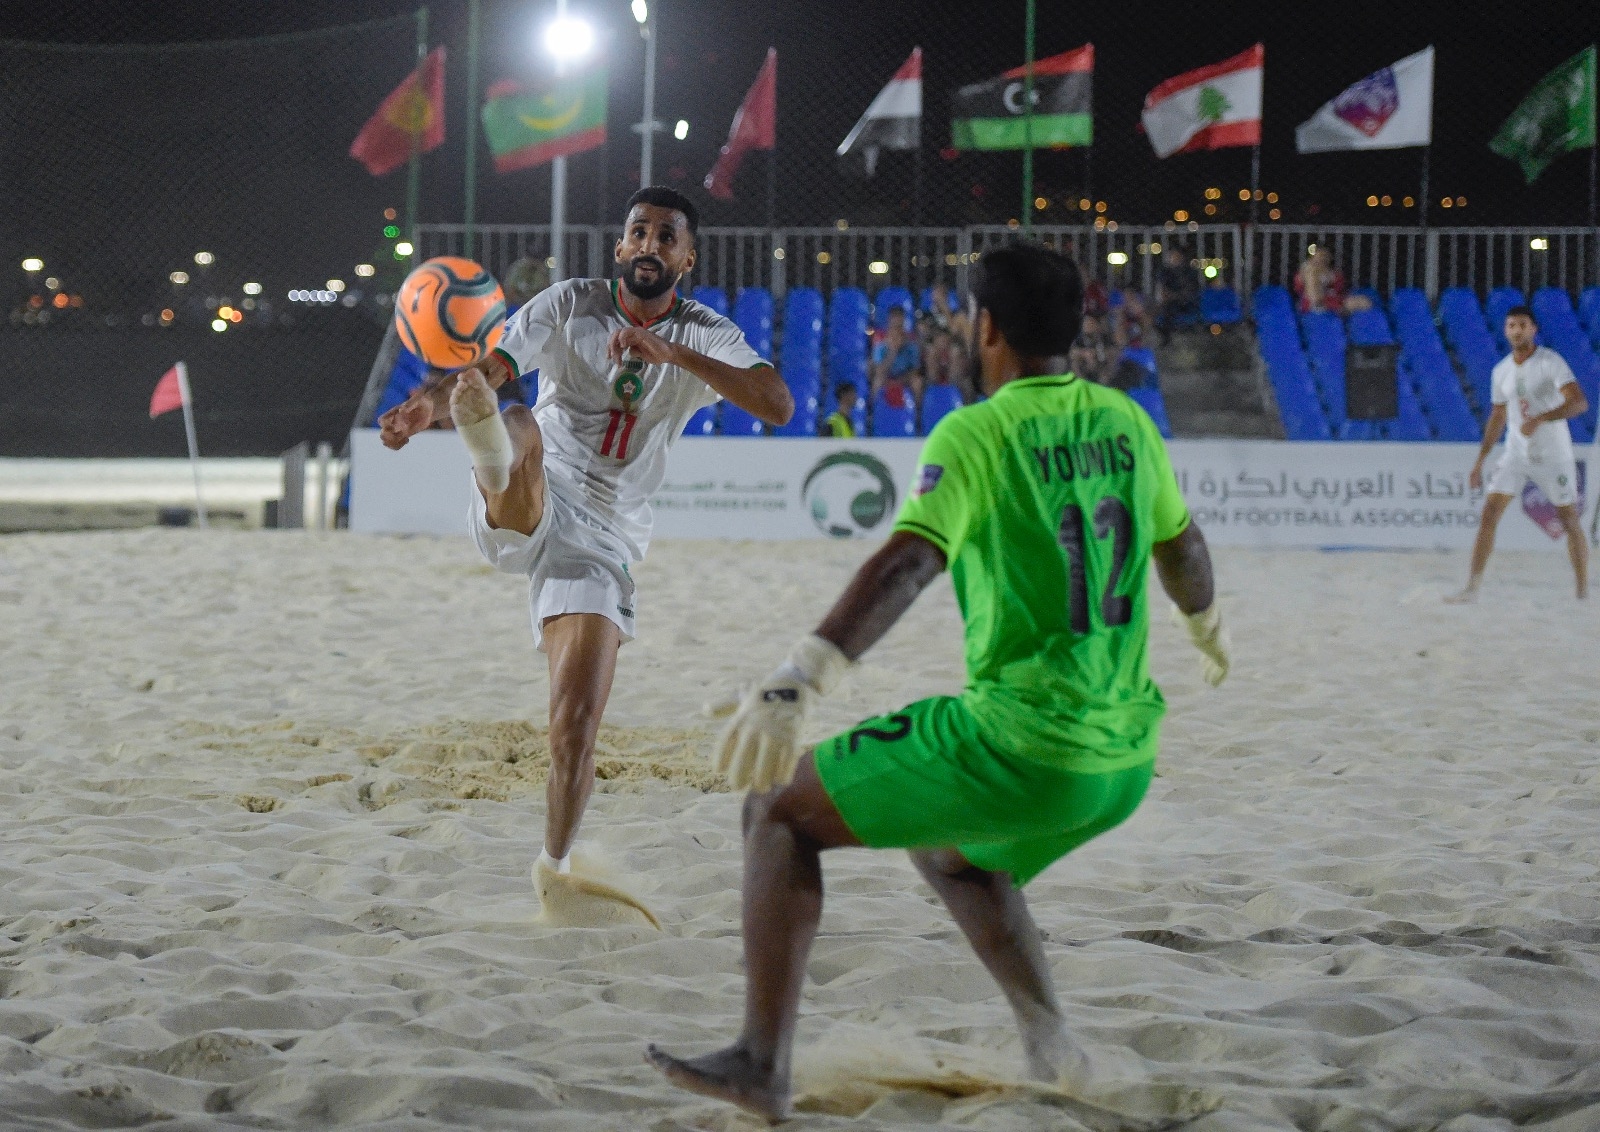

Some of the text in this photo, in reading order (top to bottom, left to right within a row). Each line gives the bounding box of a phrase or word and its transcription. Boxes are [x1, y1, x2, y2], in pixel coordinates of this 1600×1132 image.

[600, 408, 637, 460] 11
[1033, 433, 1135, 483] YOUNIS
[1233, 506, 1344, 528] FOOTBALL
[1352, 507, 1480, 529] ASSOCIATIO
[1057, 495, 1133, 634] 12
